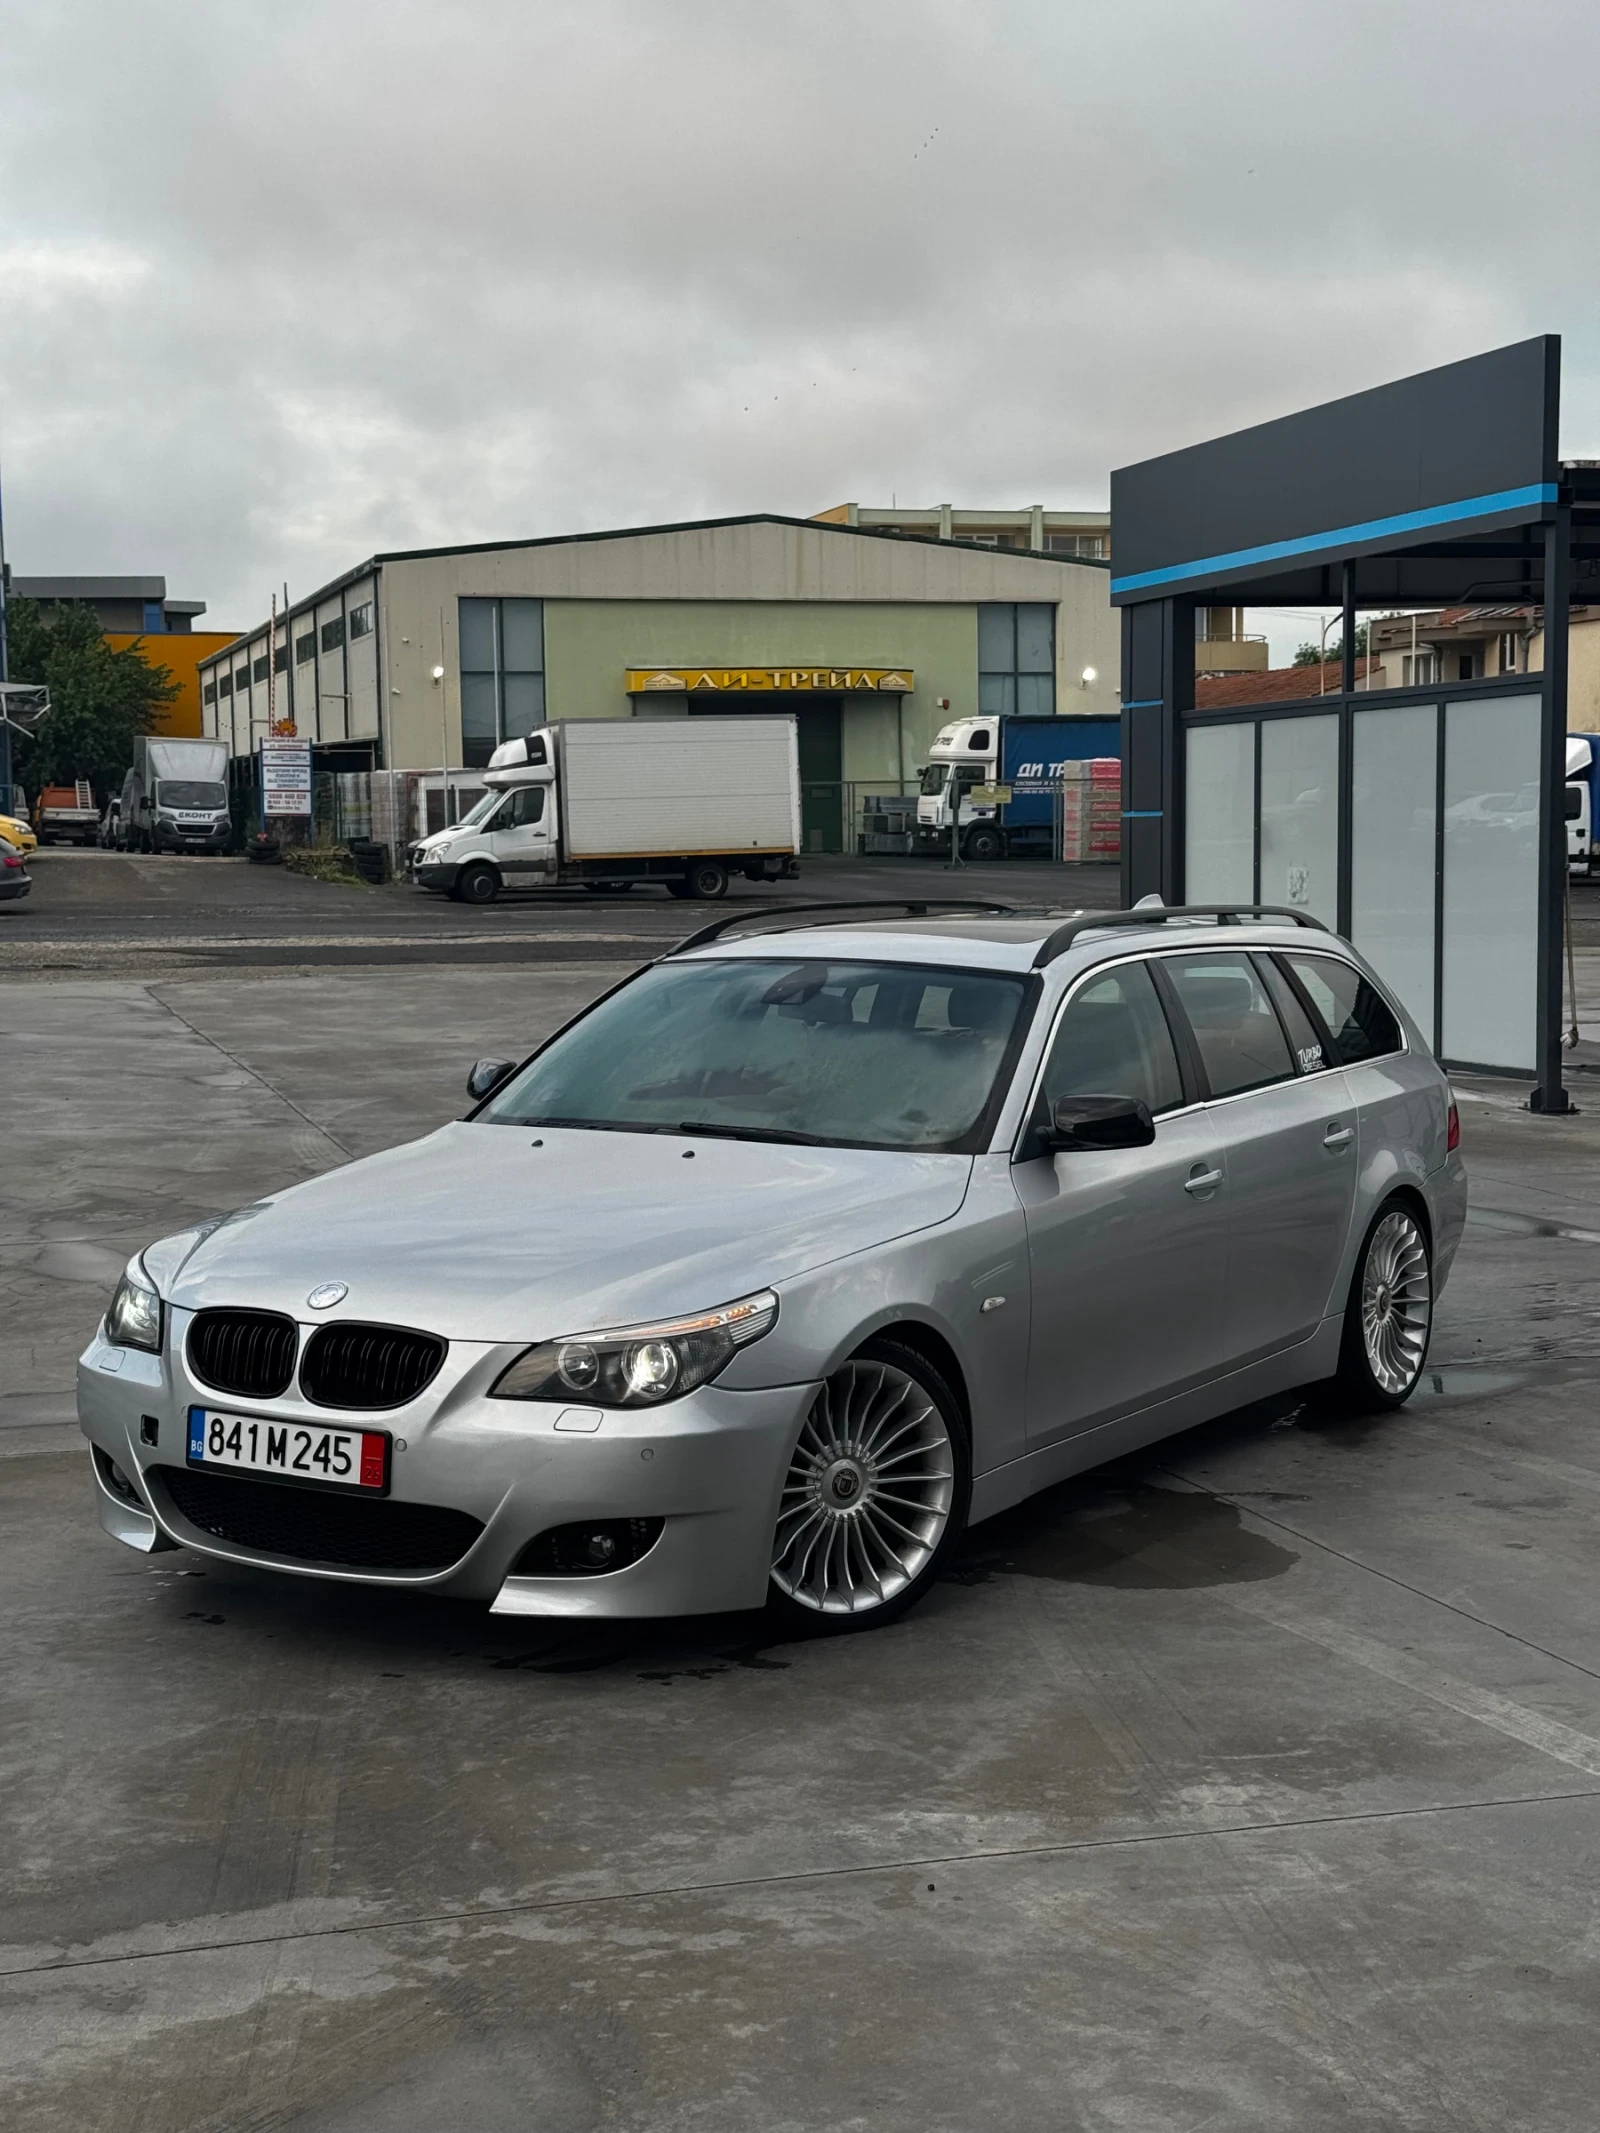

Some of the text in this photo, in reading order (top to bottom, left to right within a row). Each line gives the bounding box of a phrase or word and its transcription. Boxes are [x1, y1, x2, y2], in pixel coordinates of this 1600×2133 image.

[690, 669, 876, 690] ДИ-ТРЕЙД
[1016, 763, 1044, 777] ДИ
[1298, 1045, 1321, 1065] TURBO
[1303, 1060, 1327, 1072] DIESEL
[191, 1439, 203, 1453] BG
